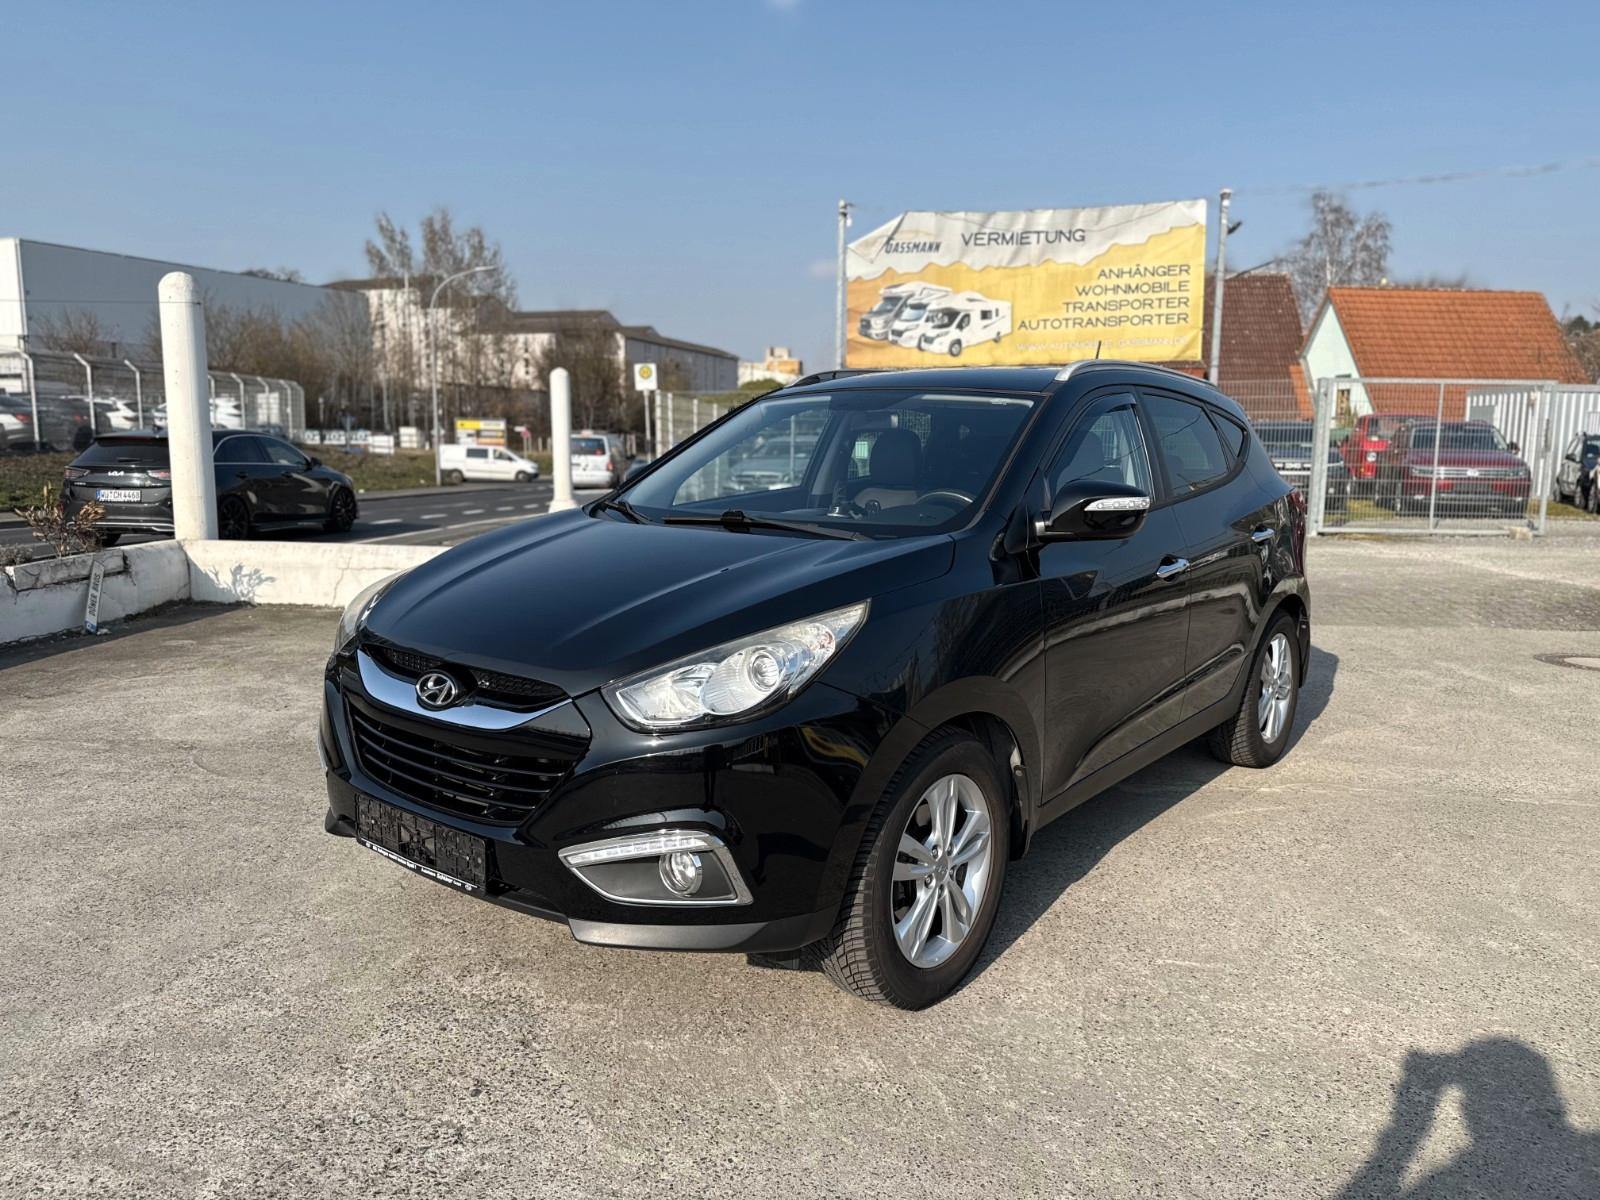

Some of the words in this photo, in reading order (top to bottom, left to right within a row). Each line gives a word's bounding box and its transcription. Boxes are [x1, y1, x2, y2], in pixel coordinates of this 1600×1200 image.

[884, 238, 942, 254] GASSMANN
[961, 228, 1086, 247] VERMIETUNG
[1097, 263, 1191, 280] ANHÄNGER
[1075, 280, 1190, 297] WOHNMOBILE
[1063, 297, 1190, 313] TRANSPORTER
[1017, 313, 1189, 331] AUTOTRANSPORTER
